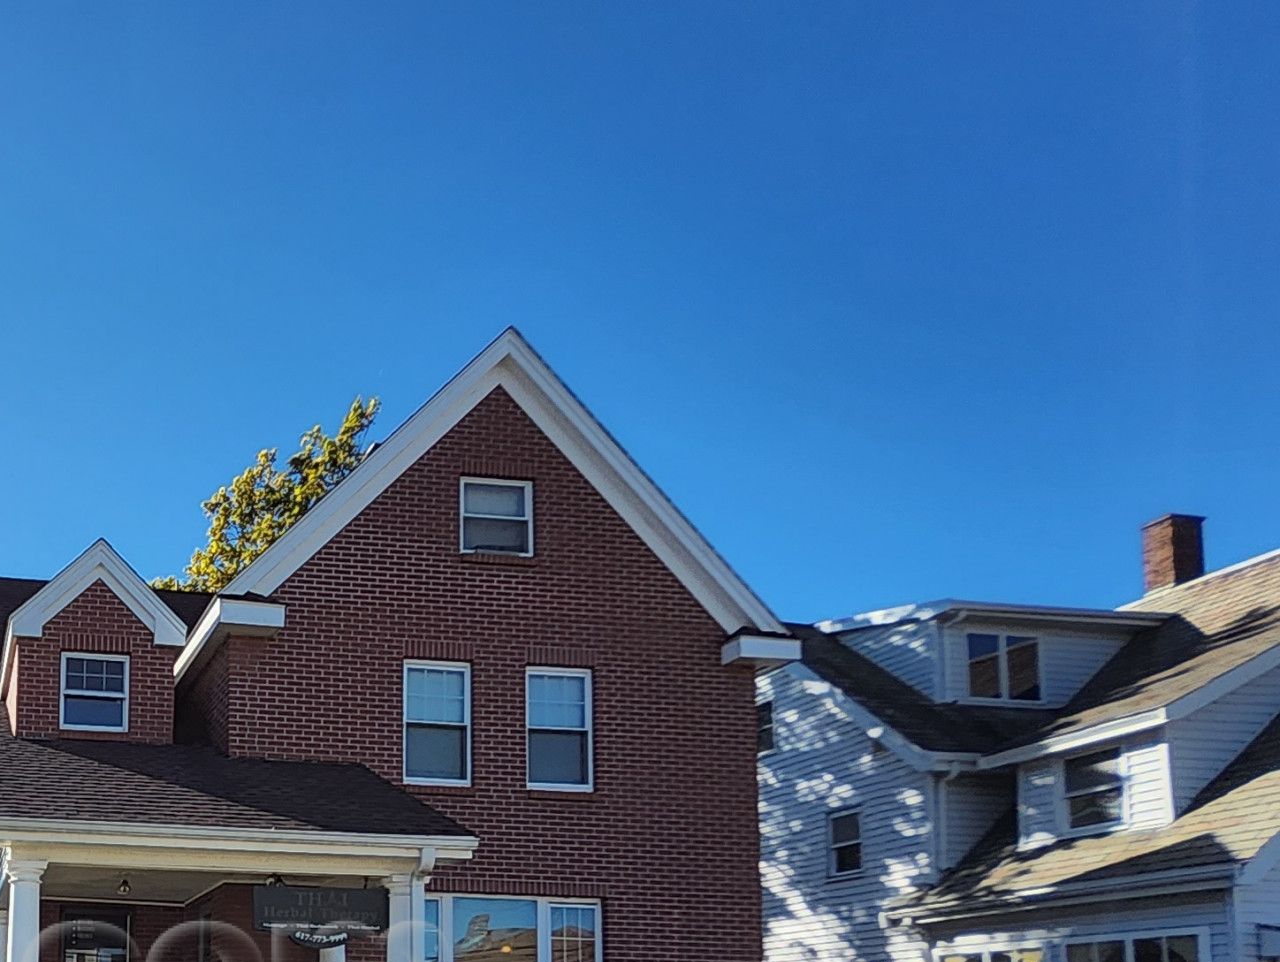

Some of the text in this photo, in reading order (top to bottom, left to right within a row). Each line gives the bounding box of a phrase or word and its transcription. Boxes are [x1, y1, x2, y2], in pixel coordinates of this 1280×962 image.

[296, 891, 348, 907] THAI
[264, 905, 379, 922] Herbal Therapy
